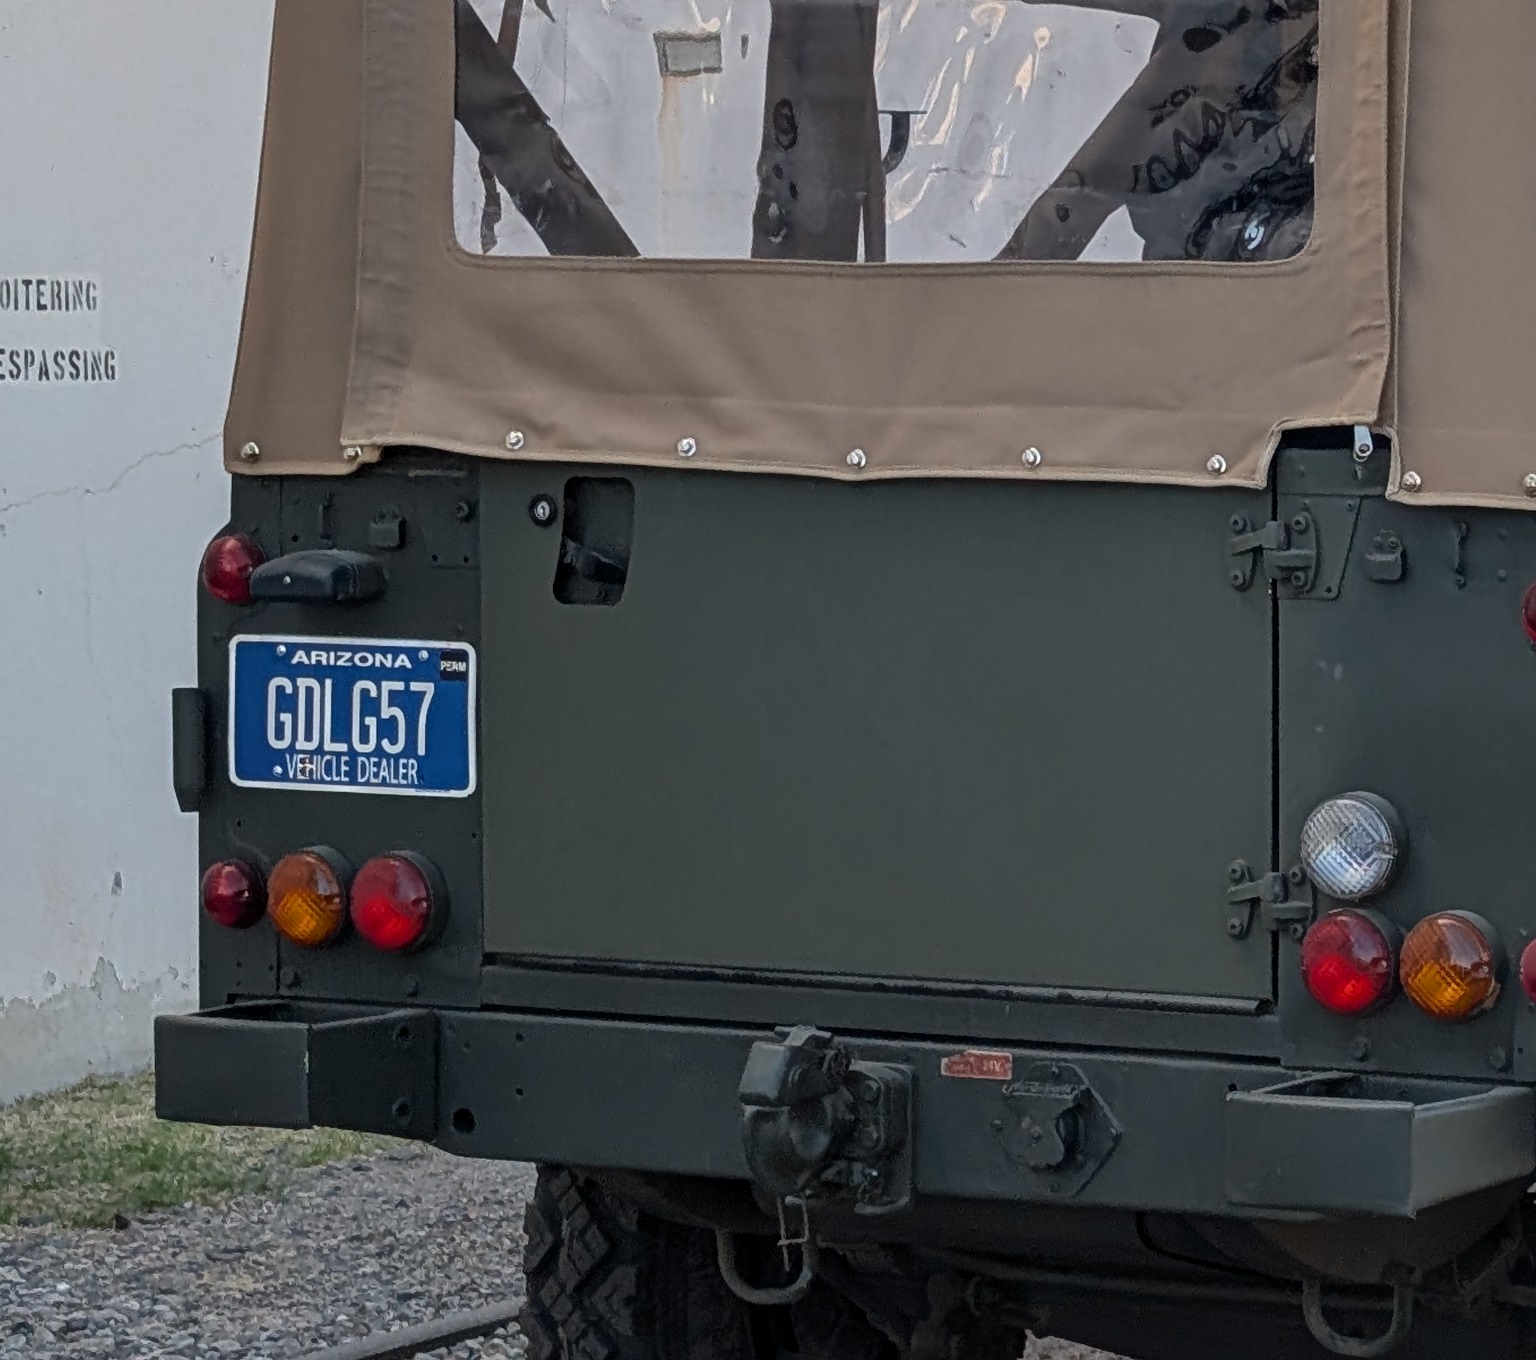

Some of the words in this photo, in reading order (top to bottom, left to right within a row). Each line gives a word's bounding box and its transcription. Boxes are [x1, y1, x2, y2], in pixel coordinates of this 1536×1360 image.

[291, 649, 412, 669] ARIZONA
[267, 676, 435, 756] GDLG57
[285, 753, 349, 782] VEHICLE
[357, 756, 419, 785] DEALER
